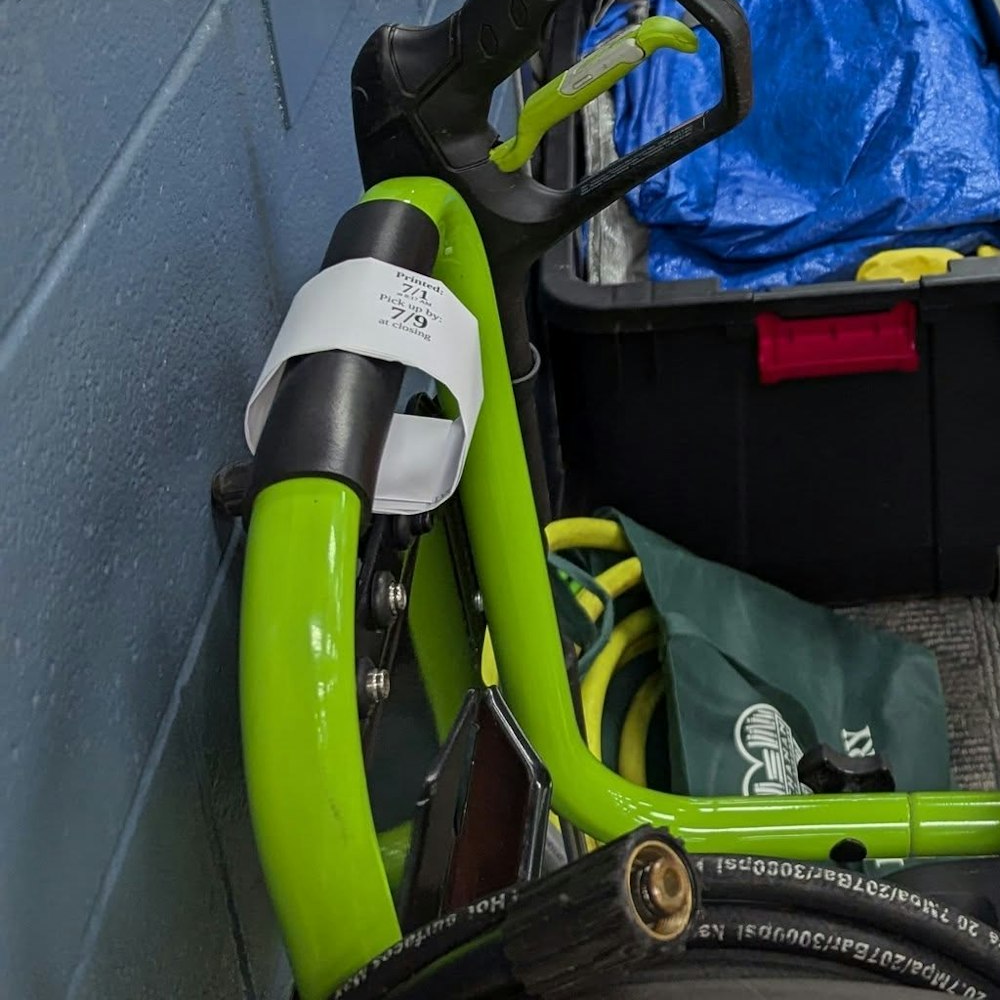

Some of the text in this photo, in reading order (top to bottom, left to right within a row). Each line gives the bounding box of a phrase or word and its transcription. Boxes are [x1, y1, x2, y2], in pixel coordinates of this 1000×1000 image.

[396, 271, 444, 296] Printed:
[402, 283, 428, 301] 7/1
[379, 293, 443, 323] Pick up by:
[391, 306, 428, 329] 7/9
[378, 318, 432, 342] at closing
